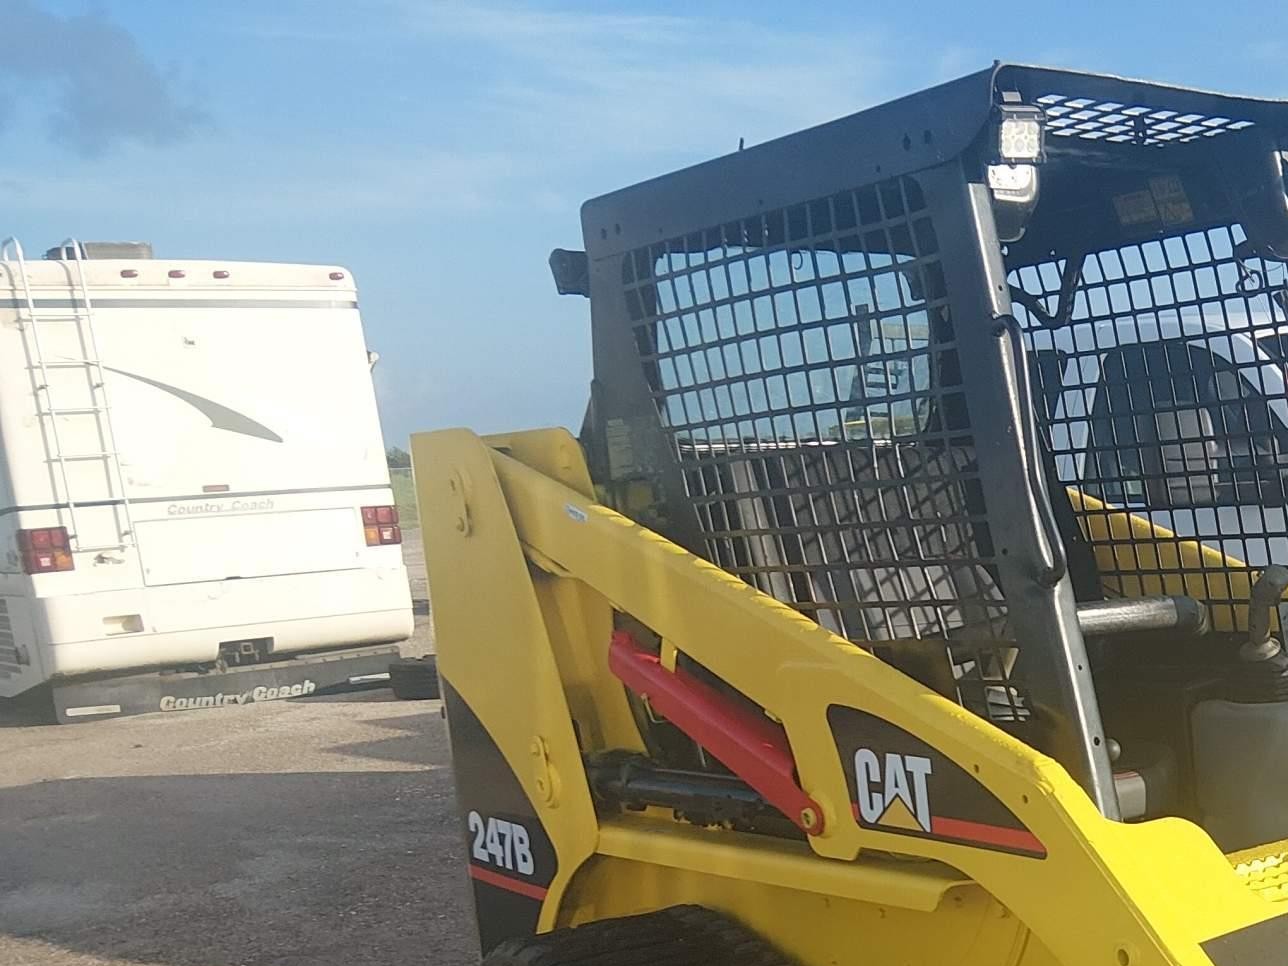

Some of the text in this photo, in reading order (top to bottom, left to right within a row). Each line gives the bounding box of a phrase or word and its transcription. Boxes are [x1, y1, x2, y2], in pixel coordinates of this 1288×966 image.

[167, 498, 275, 516] Country Coach
[159, 679, 316, 712] Country Coach
[854, 748, 932, 833] CAT
[468, 810, 535, 876] 247B
